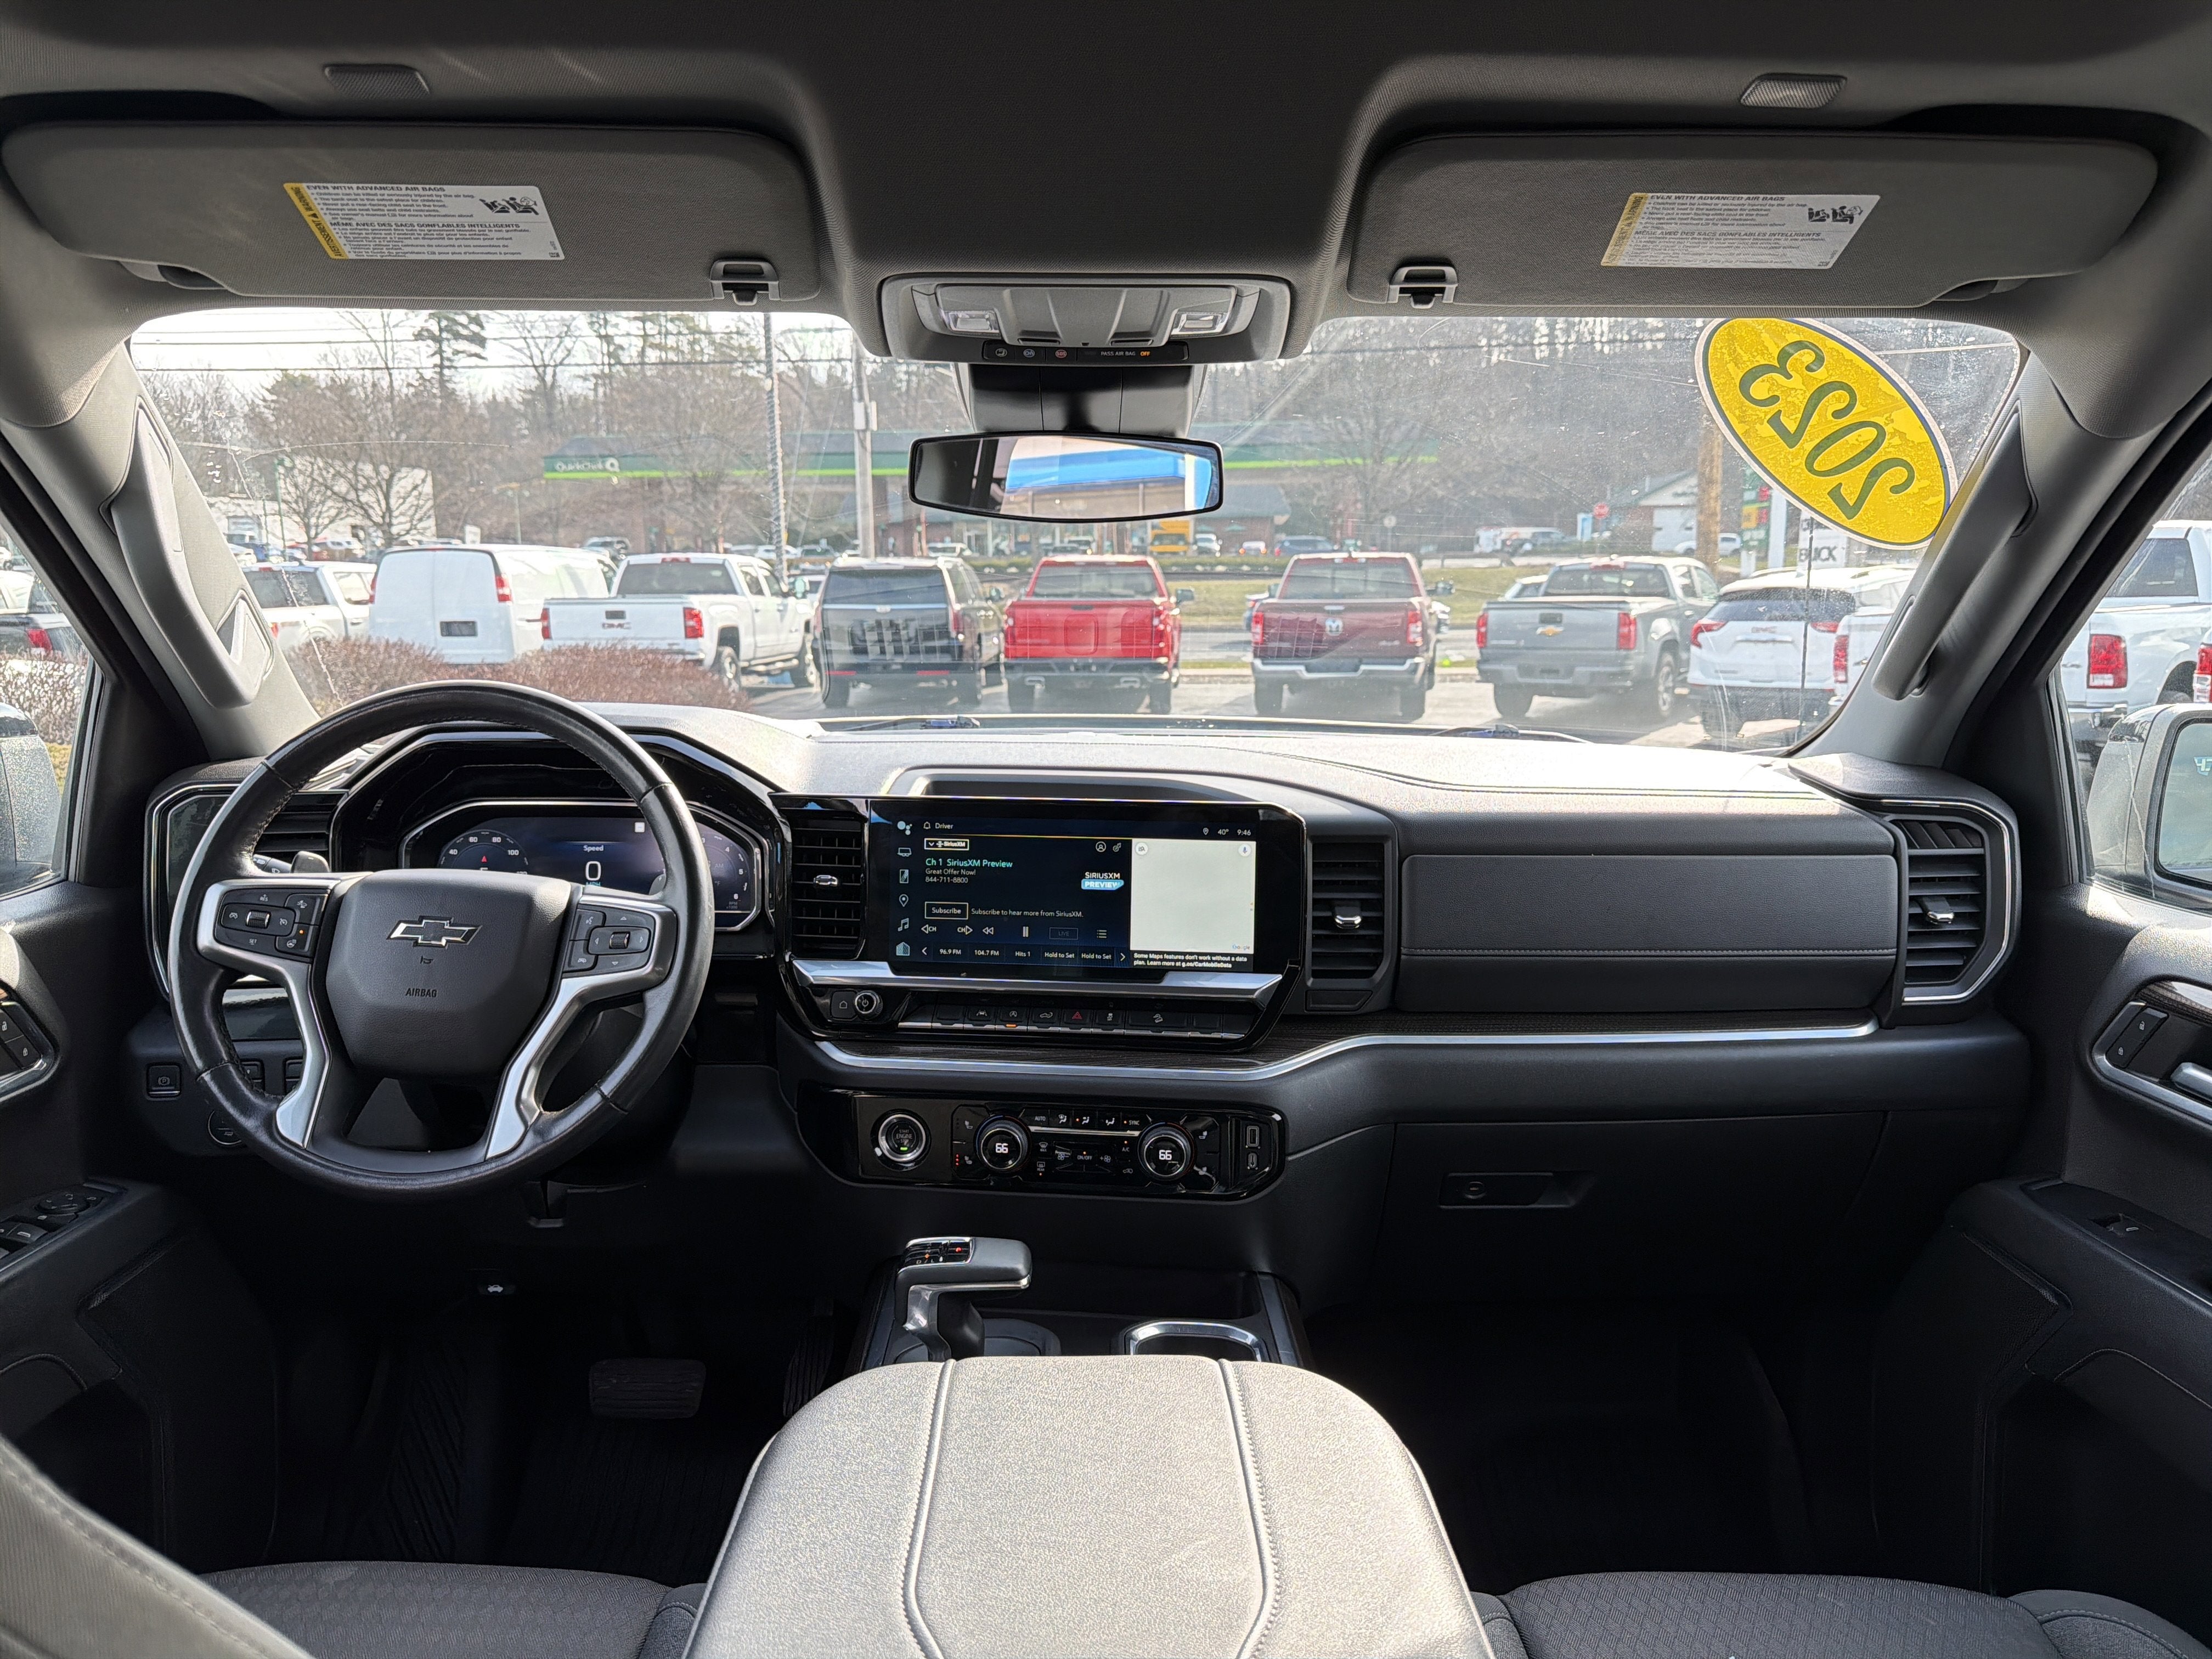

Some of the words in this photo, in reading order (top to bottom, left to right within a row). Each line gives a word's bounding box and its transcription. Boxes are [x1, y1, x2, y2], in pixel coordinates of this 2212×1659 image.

[1799, 546, 1836, 562] BICK
[947, 859, 980, 867] SiriusXM
[982, 860, 1013, 868] Preview
[585, 861, 601, 881] 0
[405, 988, 438, 997] AIRBAG
[995, 1143, 1009, 1154] 66
[1159, 1150, 1172, 1160] 66
